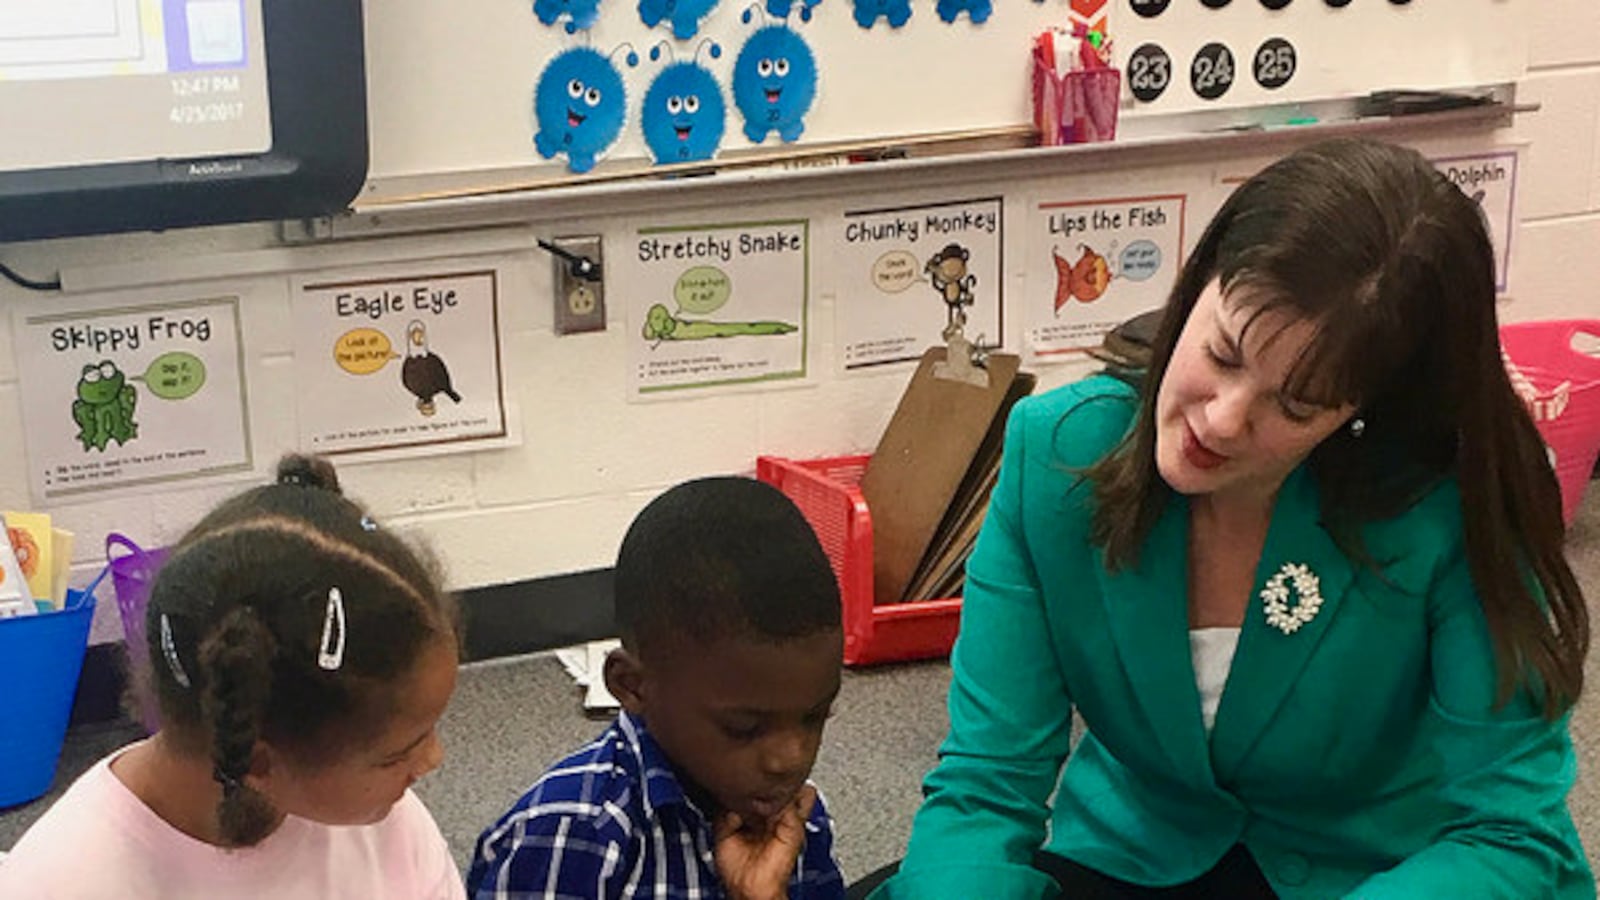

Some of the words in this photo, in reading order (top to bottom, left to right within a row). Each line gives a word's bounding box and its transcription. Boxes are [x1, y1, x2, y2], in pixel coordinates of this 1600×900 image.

[1131, 56, 1169, 90] 23
[1194, 50, 1233, 91] 24
[1257, 46, 1294, 81] 25
[171, 77, 209, 96] 12:47
[213, 75, 240, 92] PM
[169, 102, 244, 123] 4/25/2017
[1448, 163, 1505, 187] Dolphin
[845, 218, 920, 243] Chunky
[926, 210, 996, 235] Monkey
[1049, 213, 1087, 237] Lips
[1092, 210, 1122, 230] the
[1128, 206, 1167, 227] Fish
[638, 236, 731, 263] Stretchy
[739, 231, 801, 255] Snake
[335, 290, 405, 320] Eagle
[413, 287, 459, 315] Eye
[51, 325, 140, 354] Skippy
[148, 316, 212, 342] Frog
